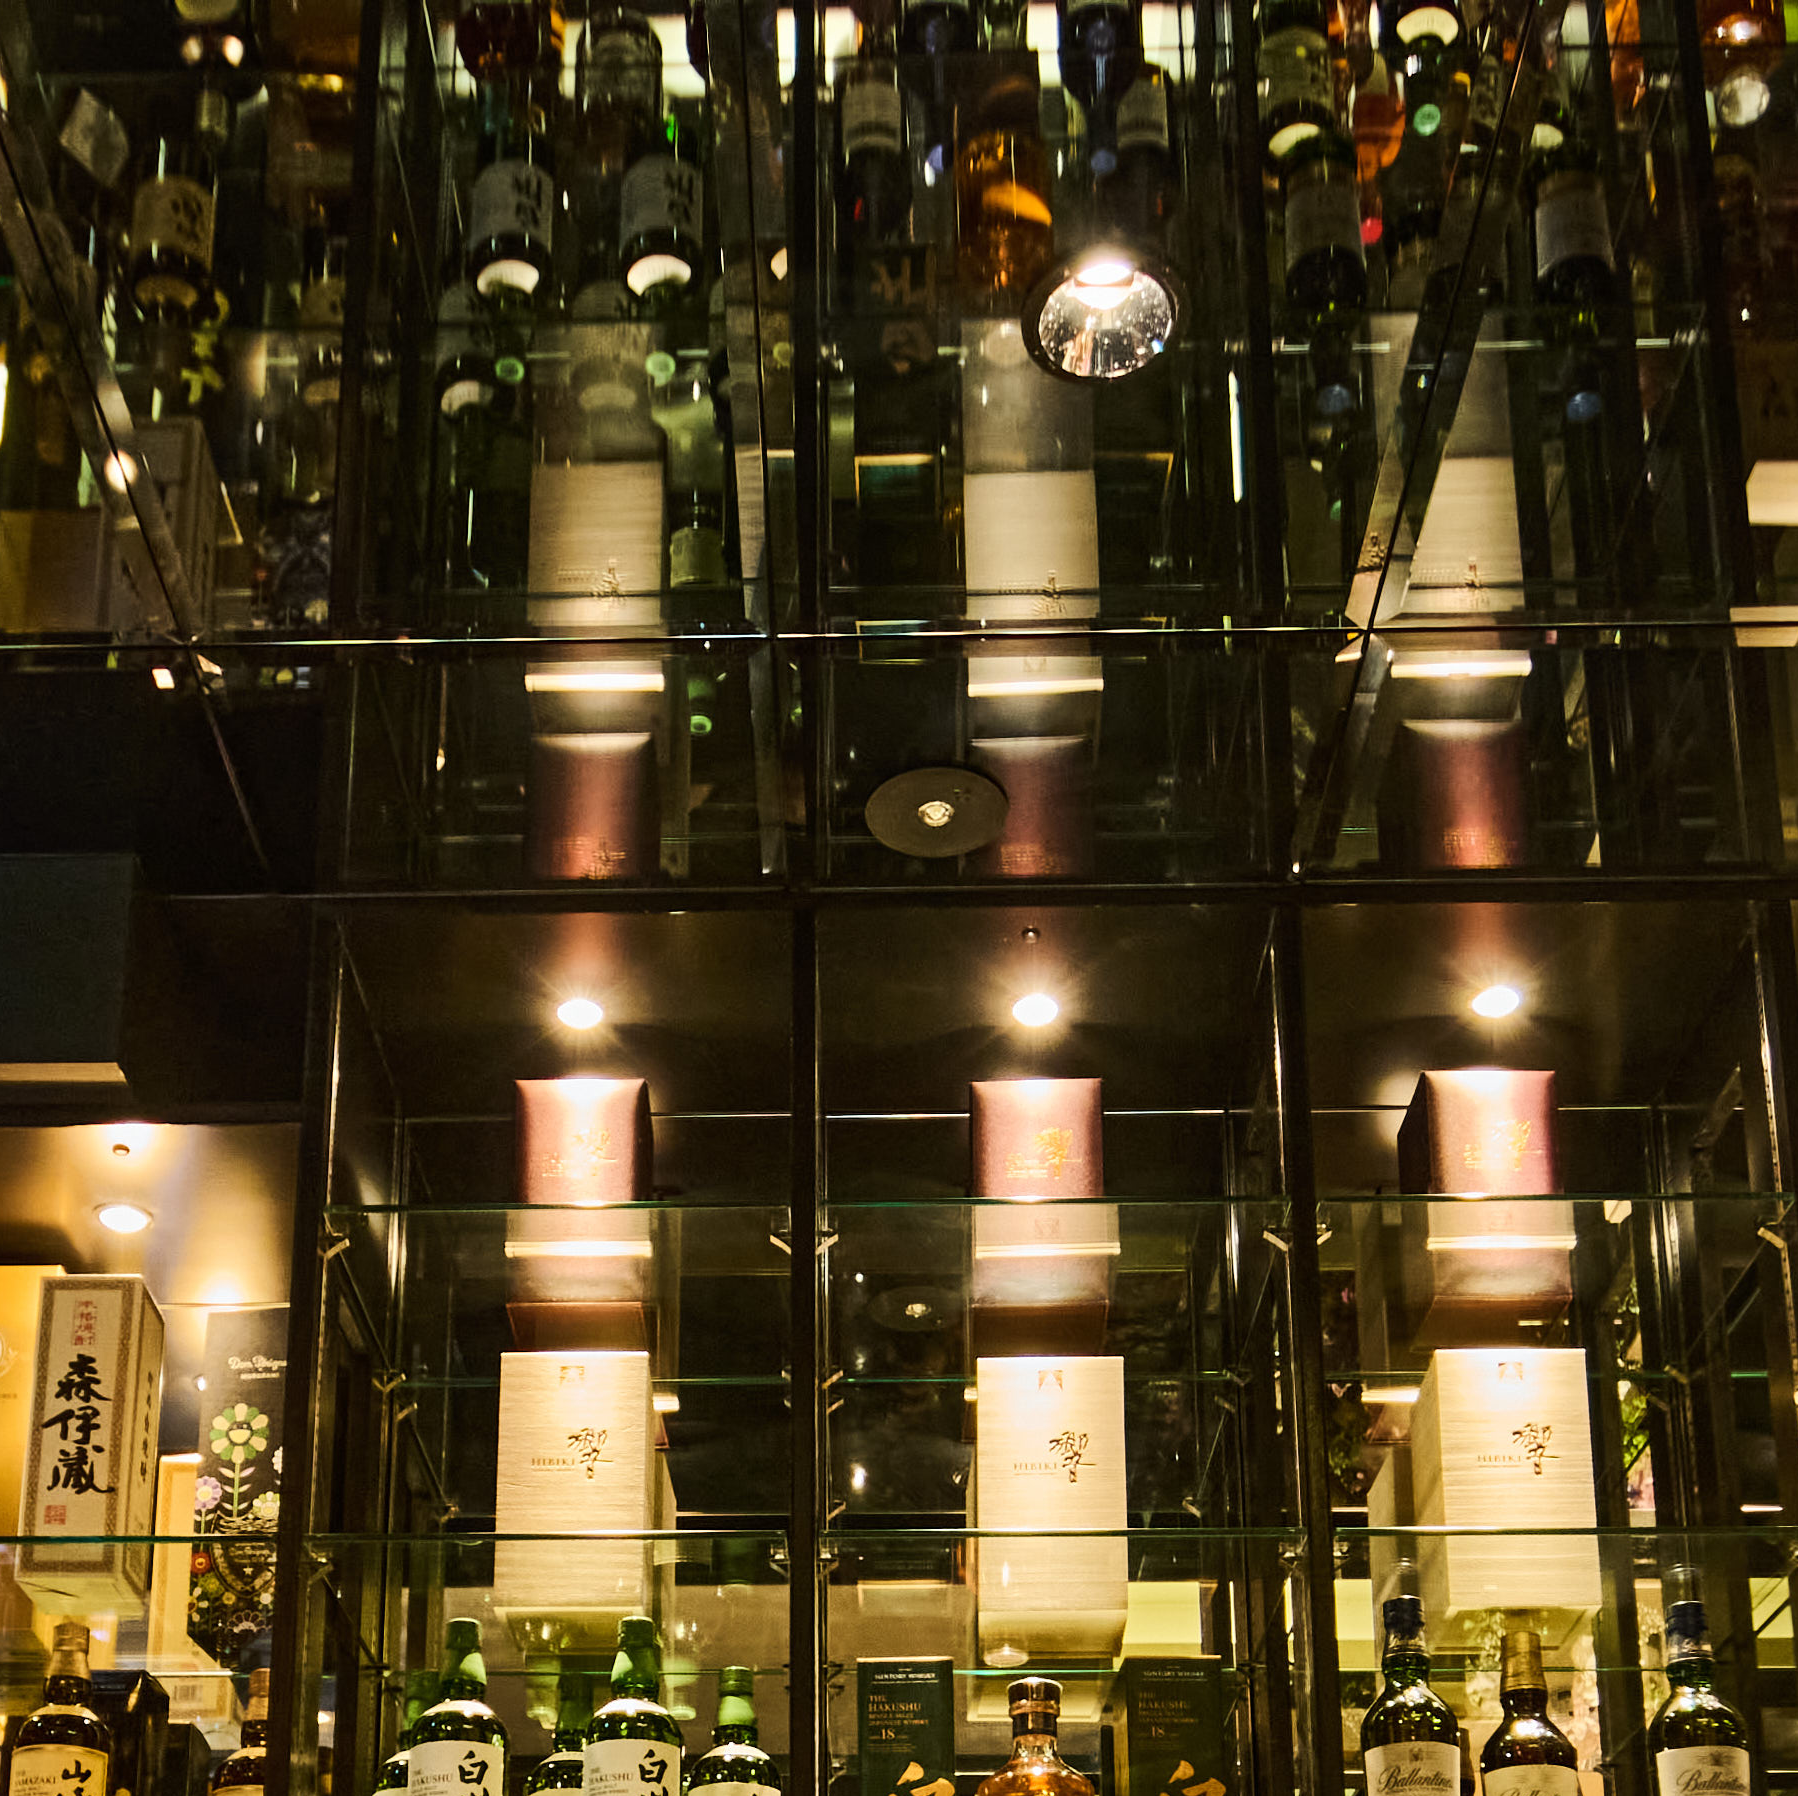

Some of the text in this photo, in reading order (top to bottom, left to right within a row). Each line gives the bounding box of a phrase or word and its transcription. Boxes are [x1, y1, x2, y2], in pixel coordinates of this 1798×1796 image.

[567, 1428, 614, 1480] 響
[1512, 1423, 1561, 1475] 響
[530, 1457, 576, 1466] HIBIKI
[1048, 1431, 1097, 1483] 響
[1013, 1462, 1058, 1471] HIBIKI
[868, 1702, 921, 1712] HAKUSHU
[881, 1728, 896, 1740] 18
